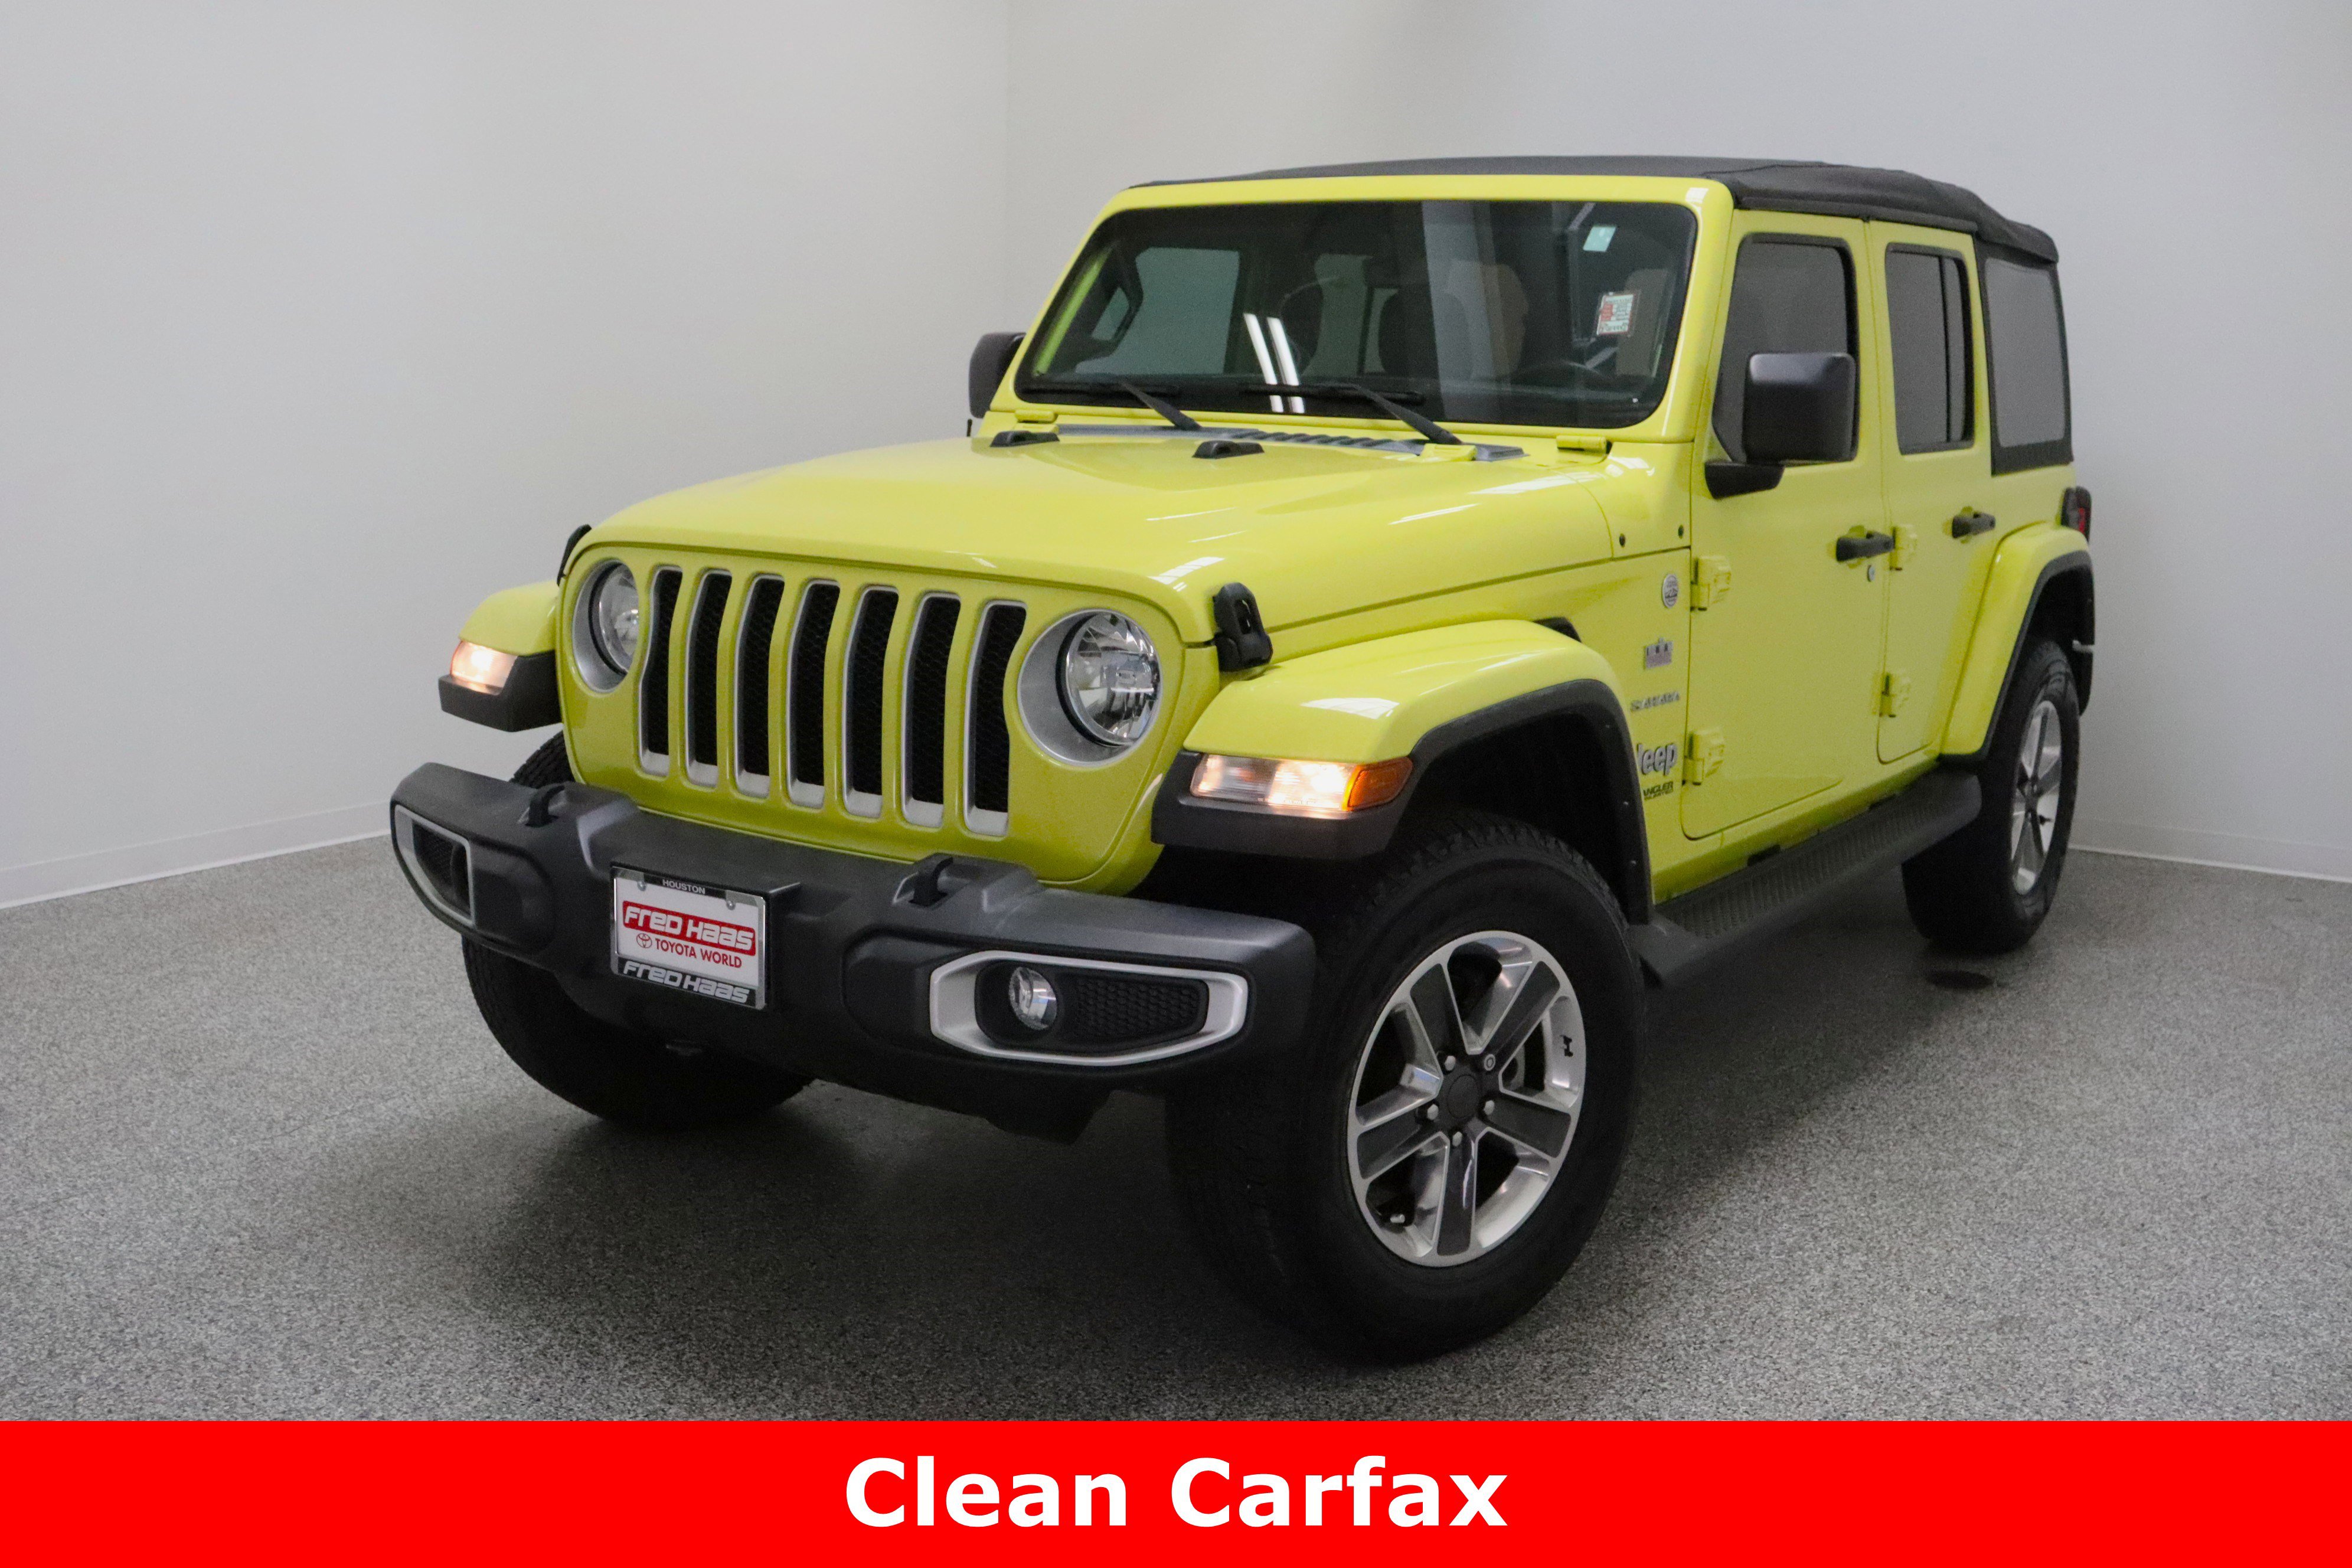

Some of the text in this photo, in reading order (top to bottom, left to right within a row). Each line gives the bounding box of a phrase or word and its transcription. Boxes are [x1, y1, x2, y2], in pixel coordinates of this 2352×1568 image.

[662, 879, 705, 894] HOUSTON
[655, 938, 742, 968] TOYOTA WORLD
